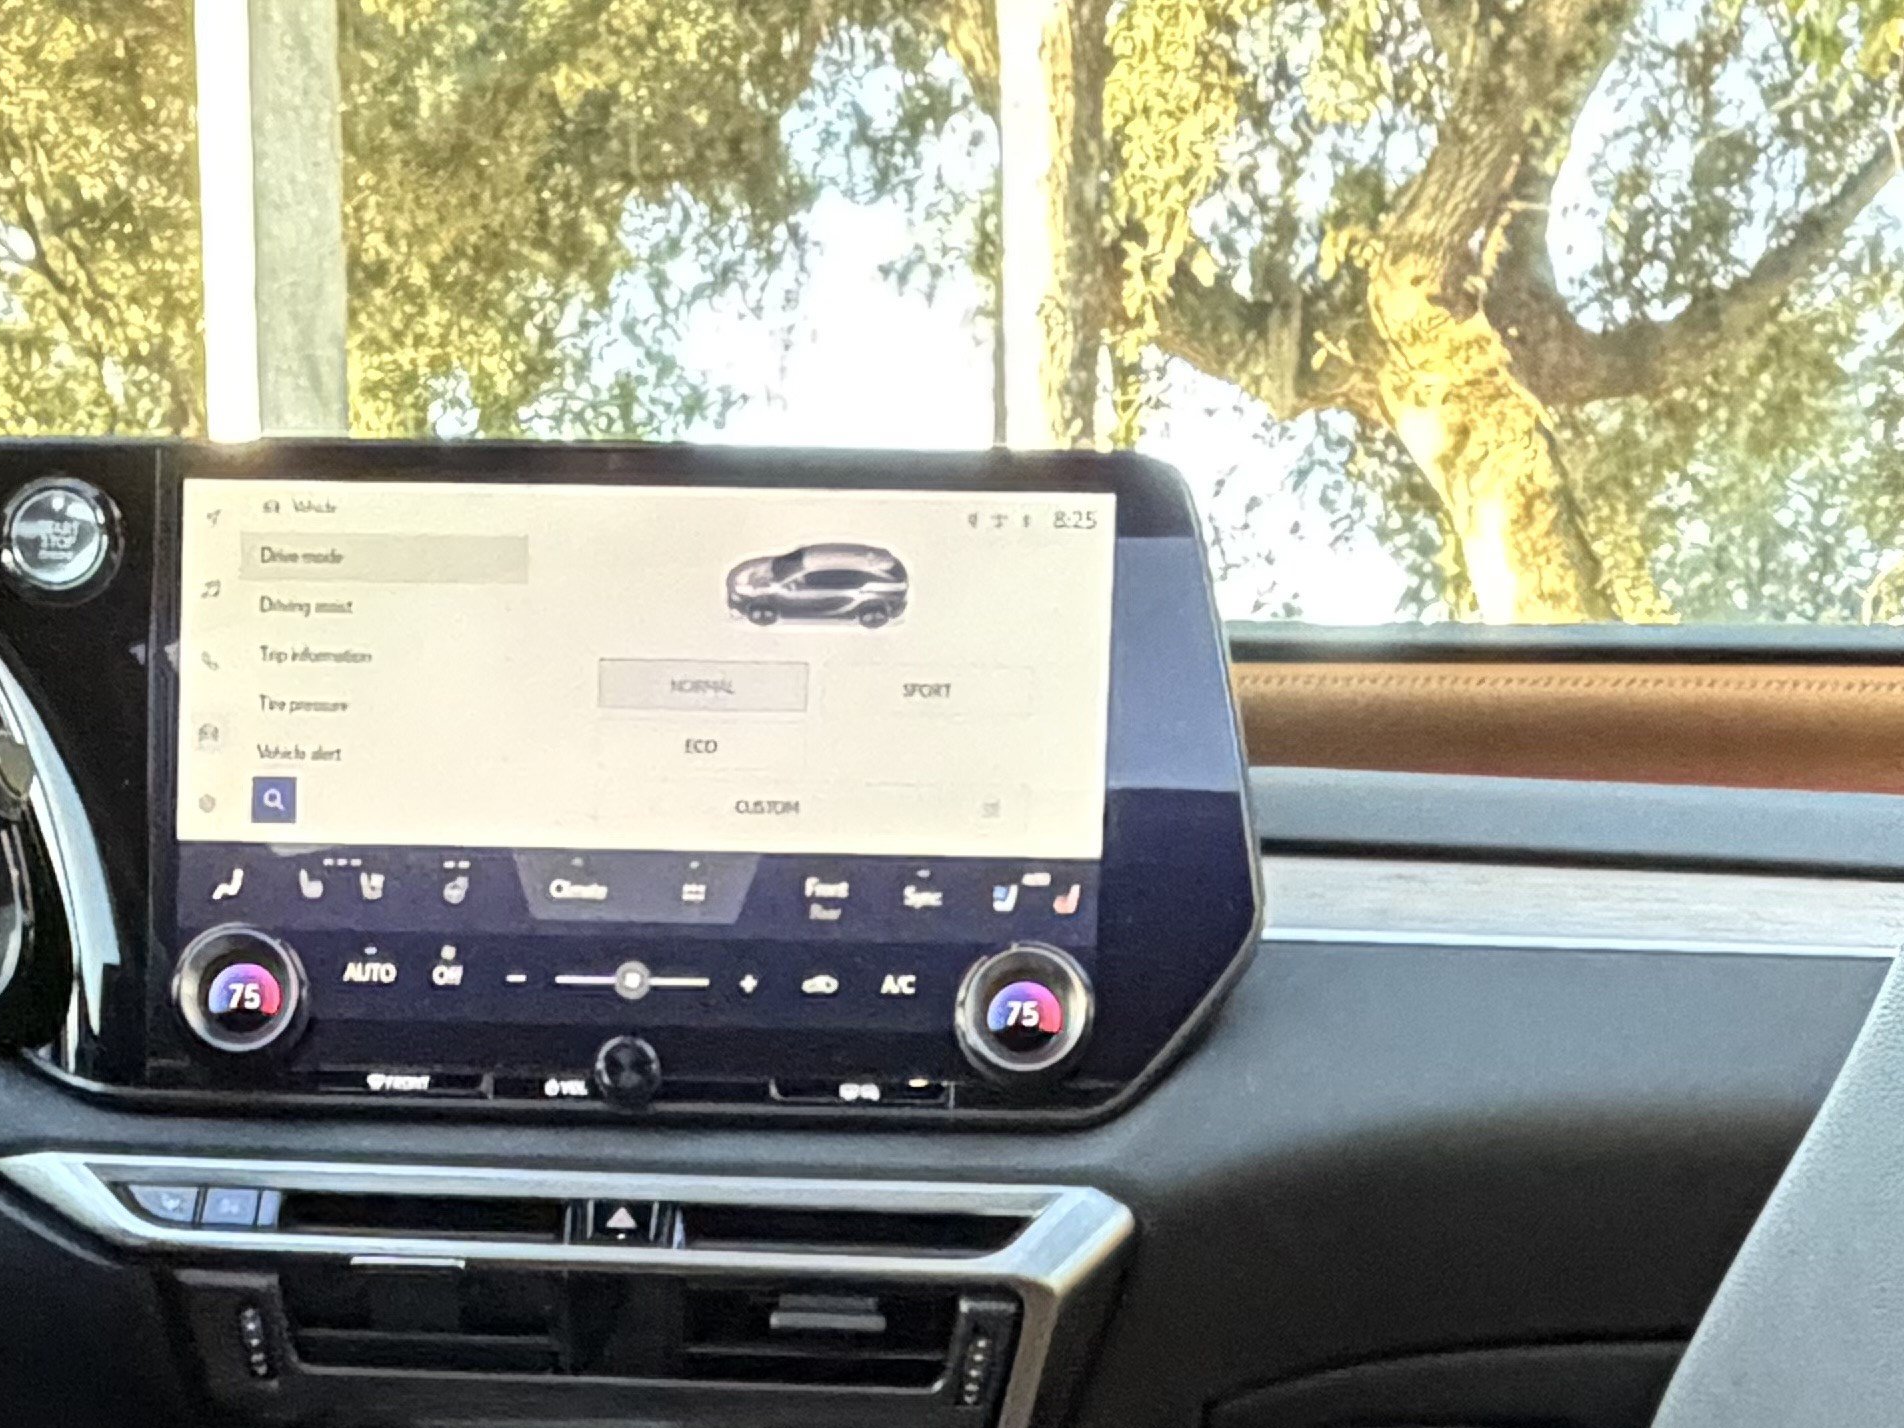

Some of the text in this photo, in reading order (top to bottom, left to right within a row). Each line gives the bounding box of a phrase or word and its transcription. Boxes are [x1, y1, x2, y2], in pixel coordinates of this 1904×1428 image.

[1053, 511, 1098, 529] 8:25
[260, 545, 345, 564] Drive mode
[259, 595, 311, 618] Driving
[259, 644, 373, 664] Trip information
[670, 678, 736, 695] NORMAL
[902, 682, 952, 699] SPORT
[258, 694, 348, 714] Tire pressure
[256, 743, 342, 761] Vehicle alert
[684, 738, 718, 754] ECO
[735, 799, 801, 815] CUSTOM
[342, 961, 398, 983] AUTO
[879, 974, 917, 995] A/C
[228, 982, 262, 1010] 75
[1006, 1000, 1040, 1028] 75
